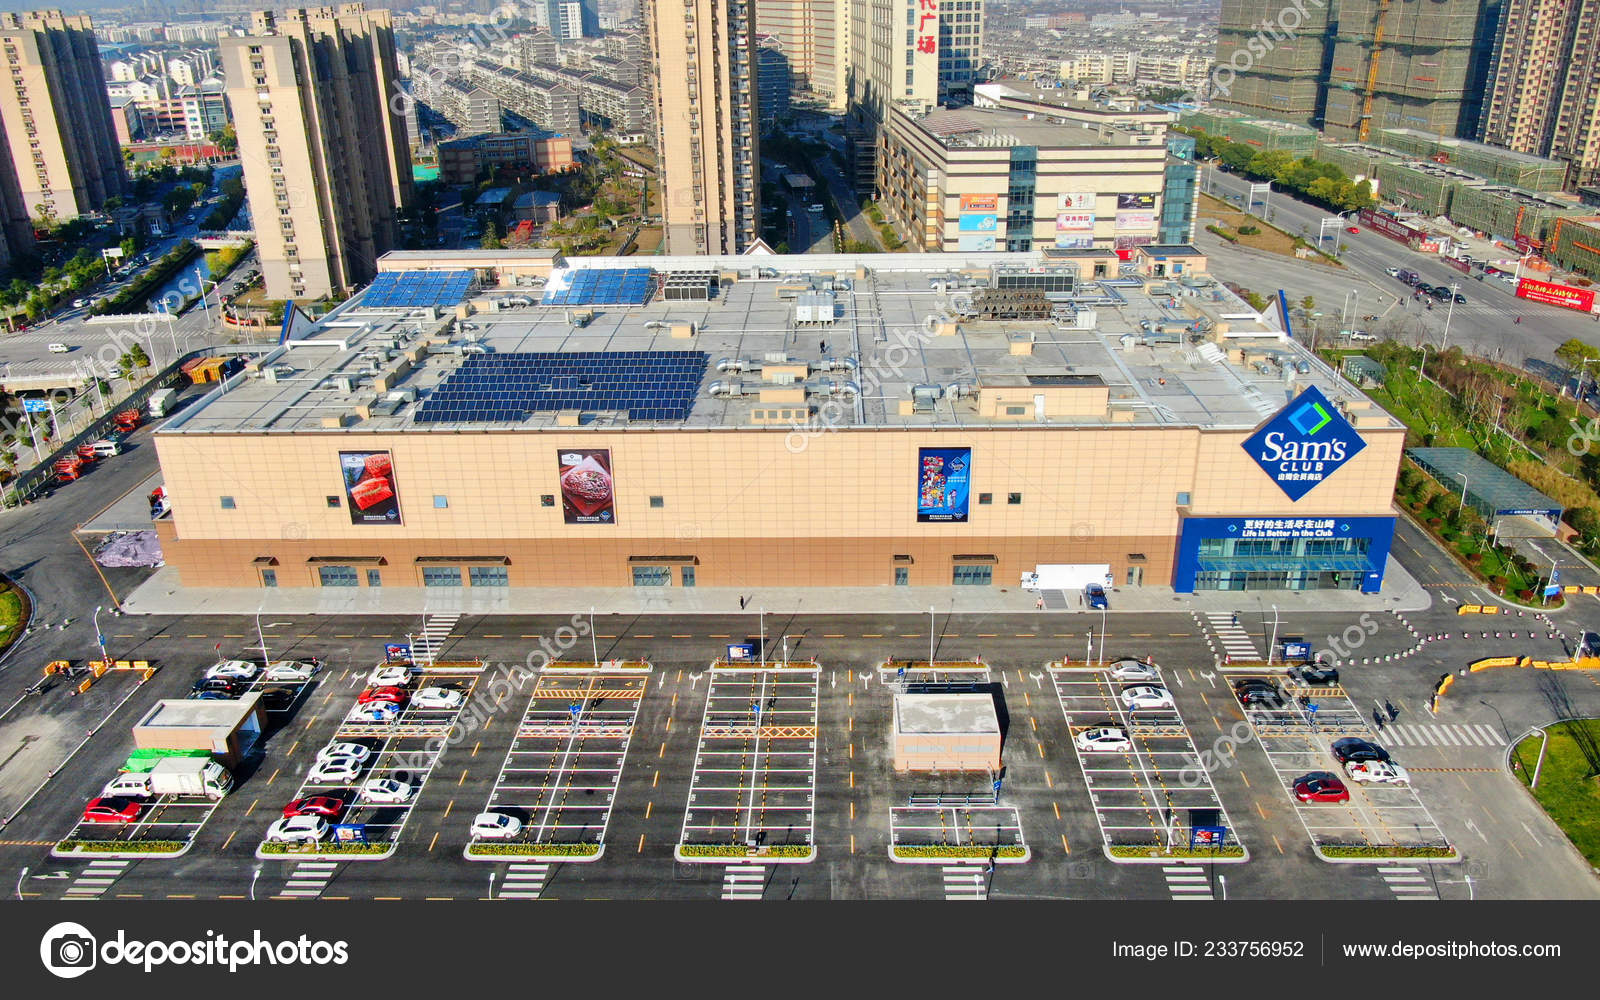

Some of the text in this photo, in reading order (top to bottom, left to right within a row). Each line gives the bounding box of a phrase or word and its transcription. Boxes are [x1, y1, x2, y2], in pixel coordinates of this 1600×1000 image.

[1261, 431, 1347, 461] Sam's
[1279, 461, 1324, 472] CLUB
[1244, 520, 1335, 529] 更好的生活尽在山姆
[1242, 529, 1334, 537] Life is Better in the Club
